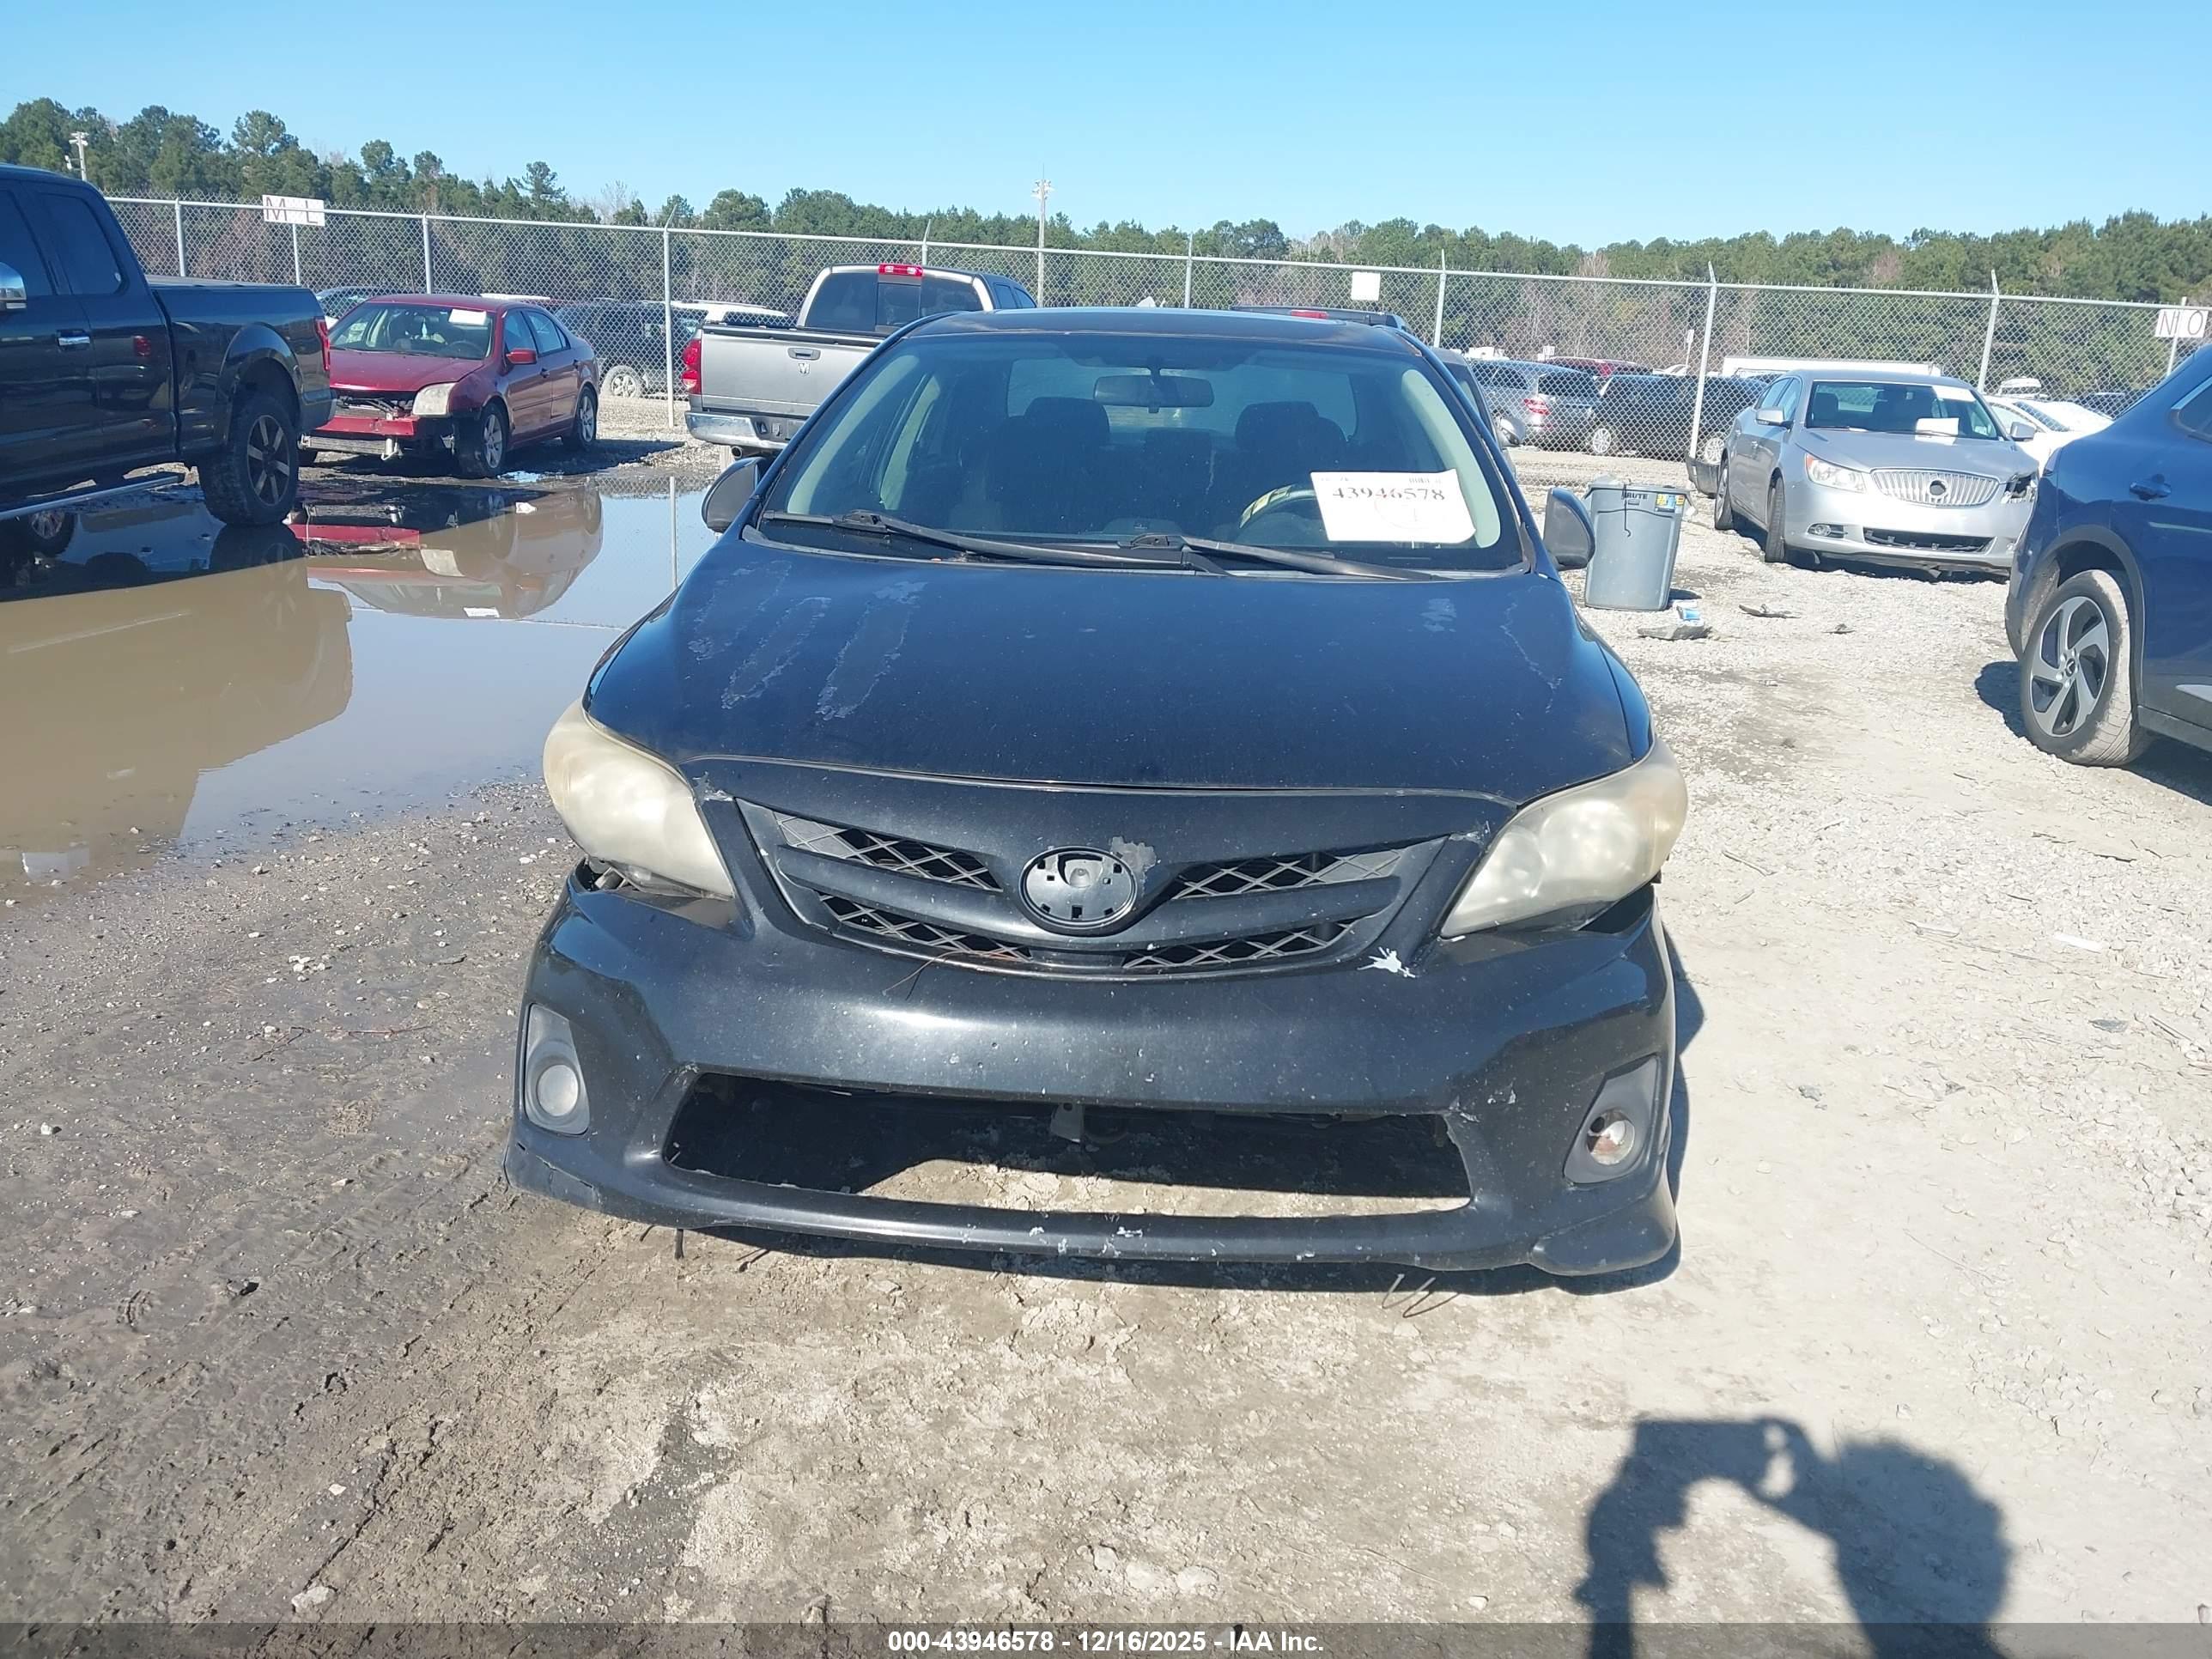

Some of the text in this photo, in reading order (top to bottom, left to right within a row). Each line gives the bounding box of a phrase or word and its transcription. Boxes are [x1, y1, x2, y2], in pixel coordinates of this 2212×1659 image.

[266, 197, 319, 223] M L
[1332, 487, 1446, 501] 43946578
